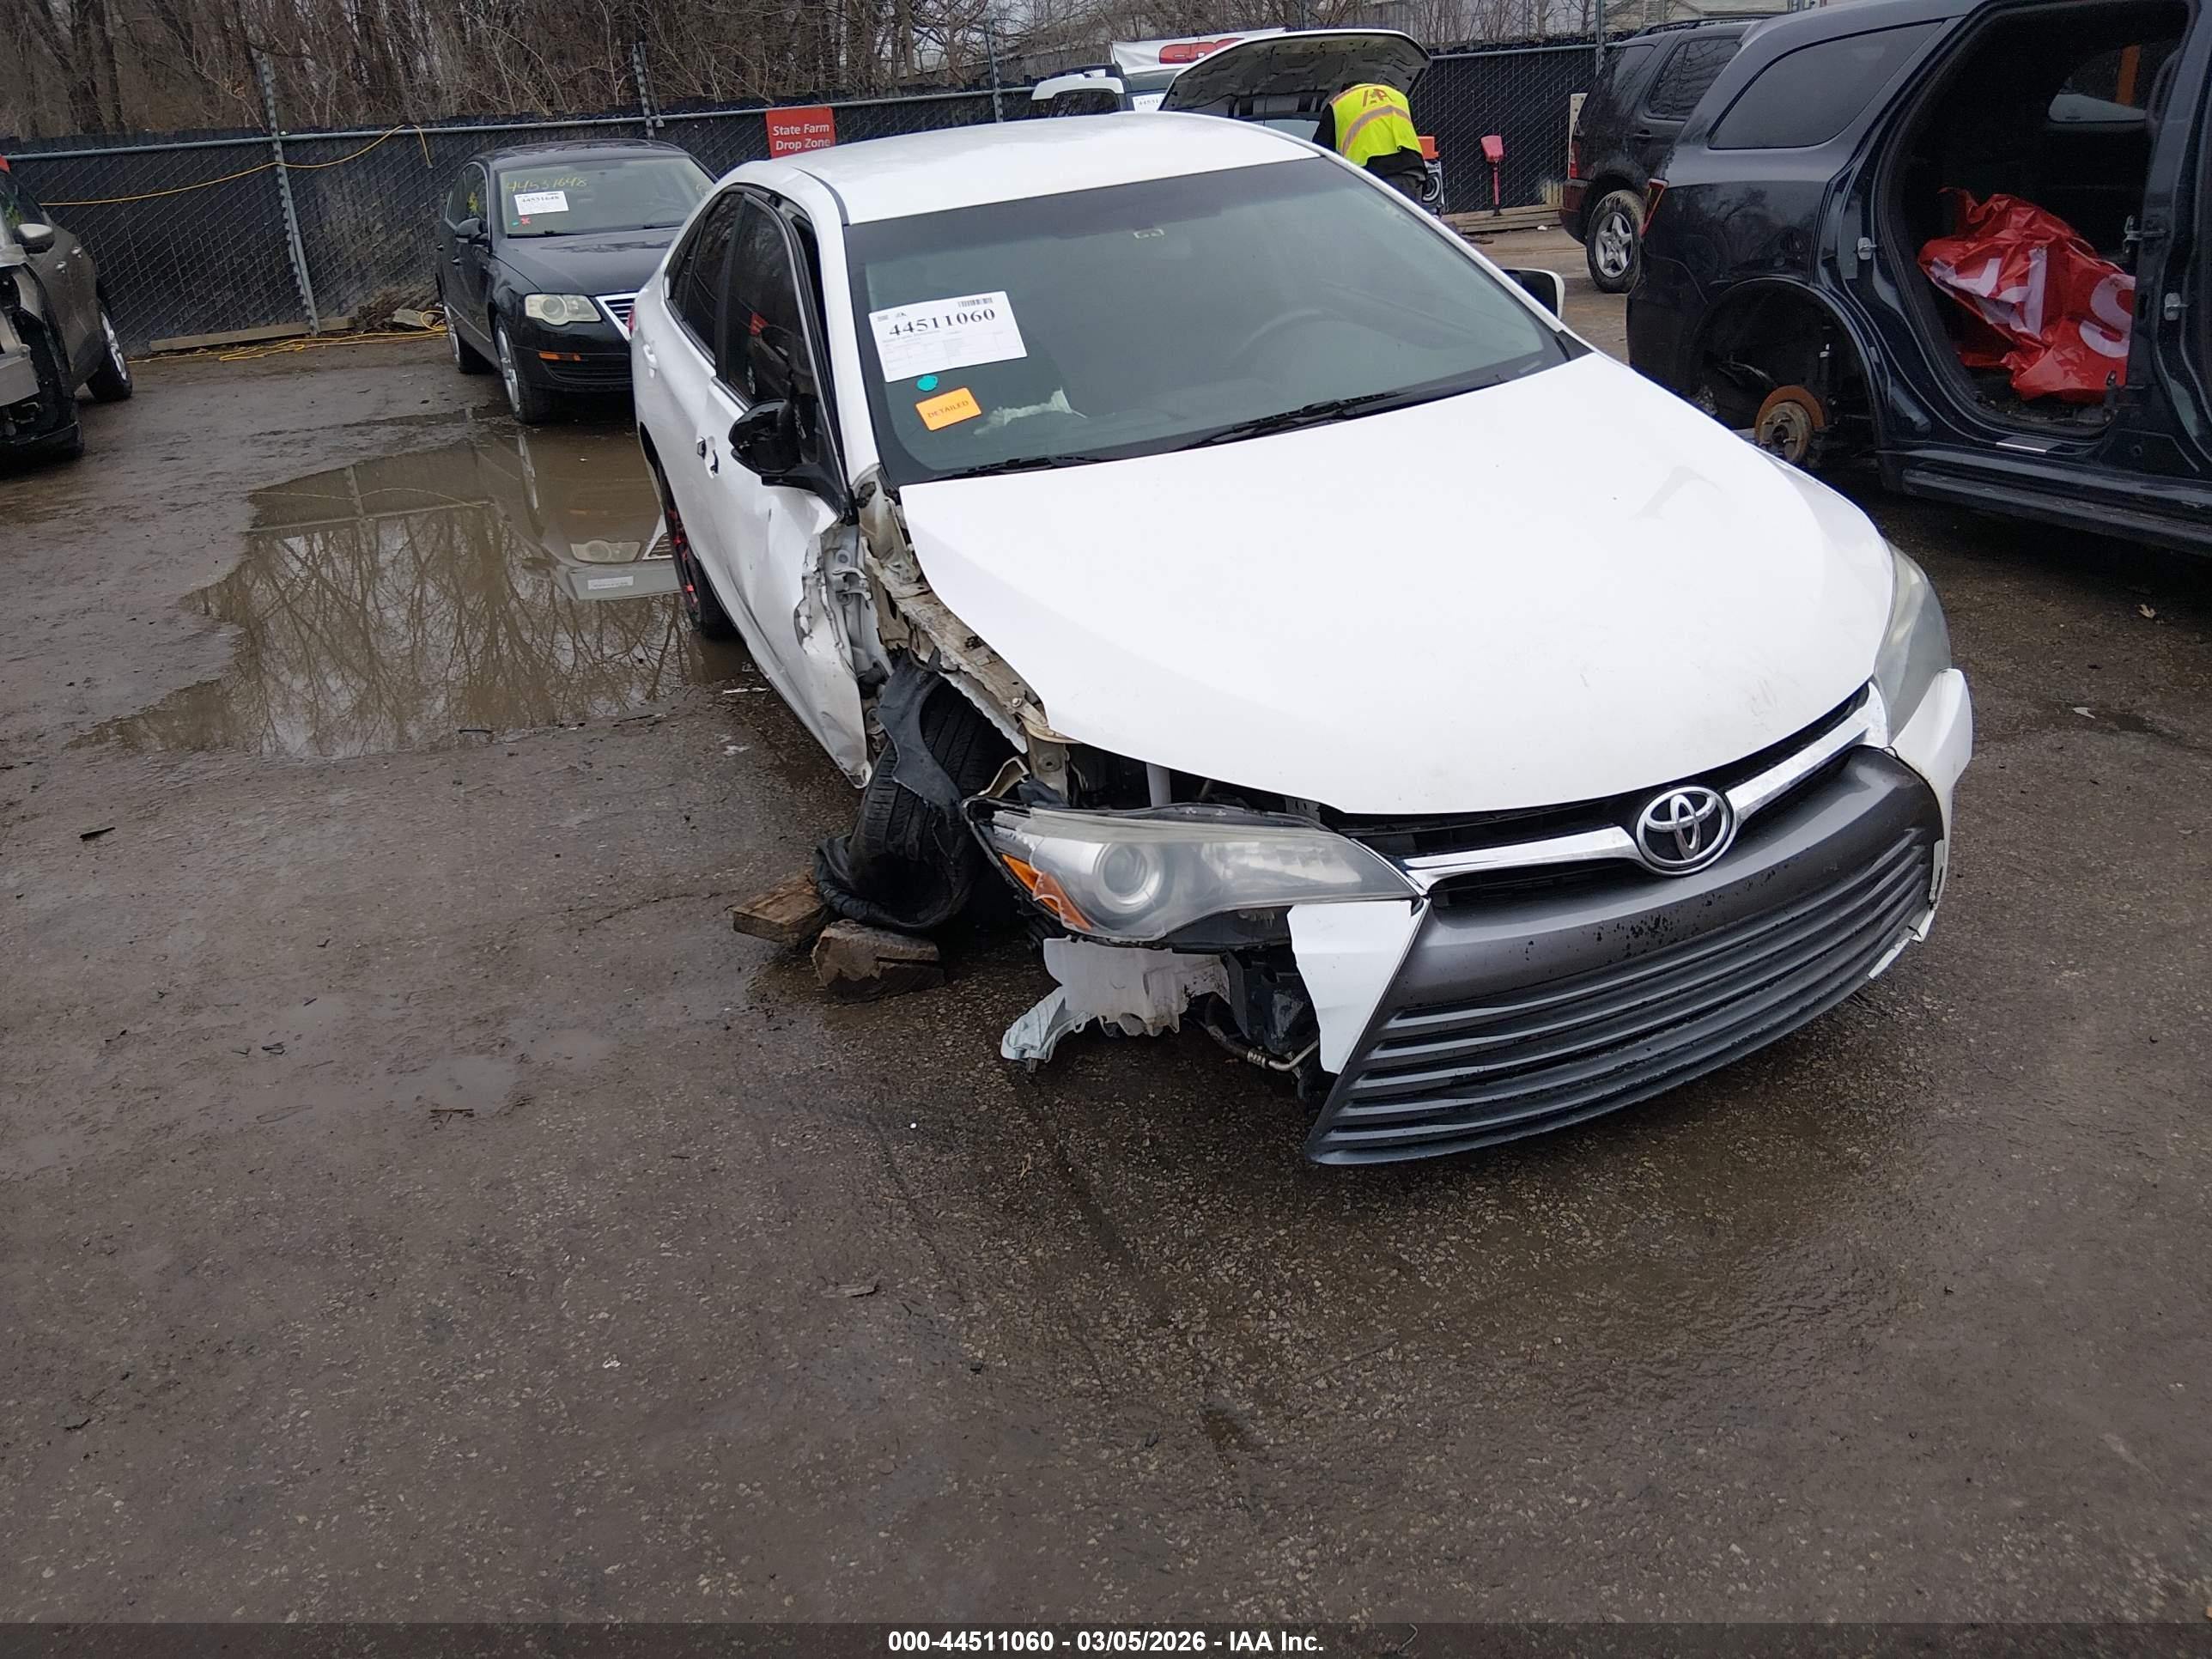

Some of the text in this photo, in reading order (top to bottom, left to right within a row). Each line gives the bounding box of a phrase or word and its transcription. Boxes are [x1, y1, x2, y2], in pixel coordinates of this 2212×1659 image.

[773, 124, 830, 137] State Farm
[775, 138, 831, 151] Drop Zone
[889, 308, 995, 337] 44511060
[927, 400, 969, 418] DETAILED
